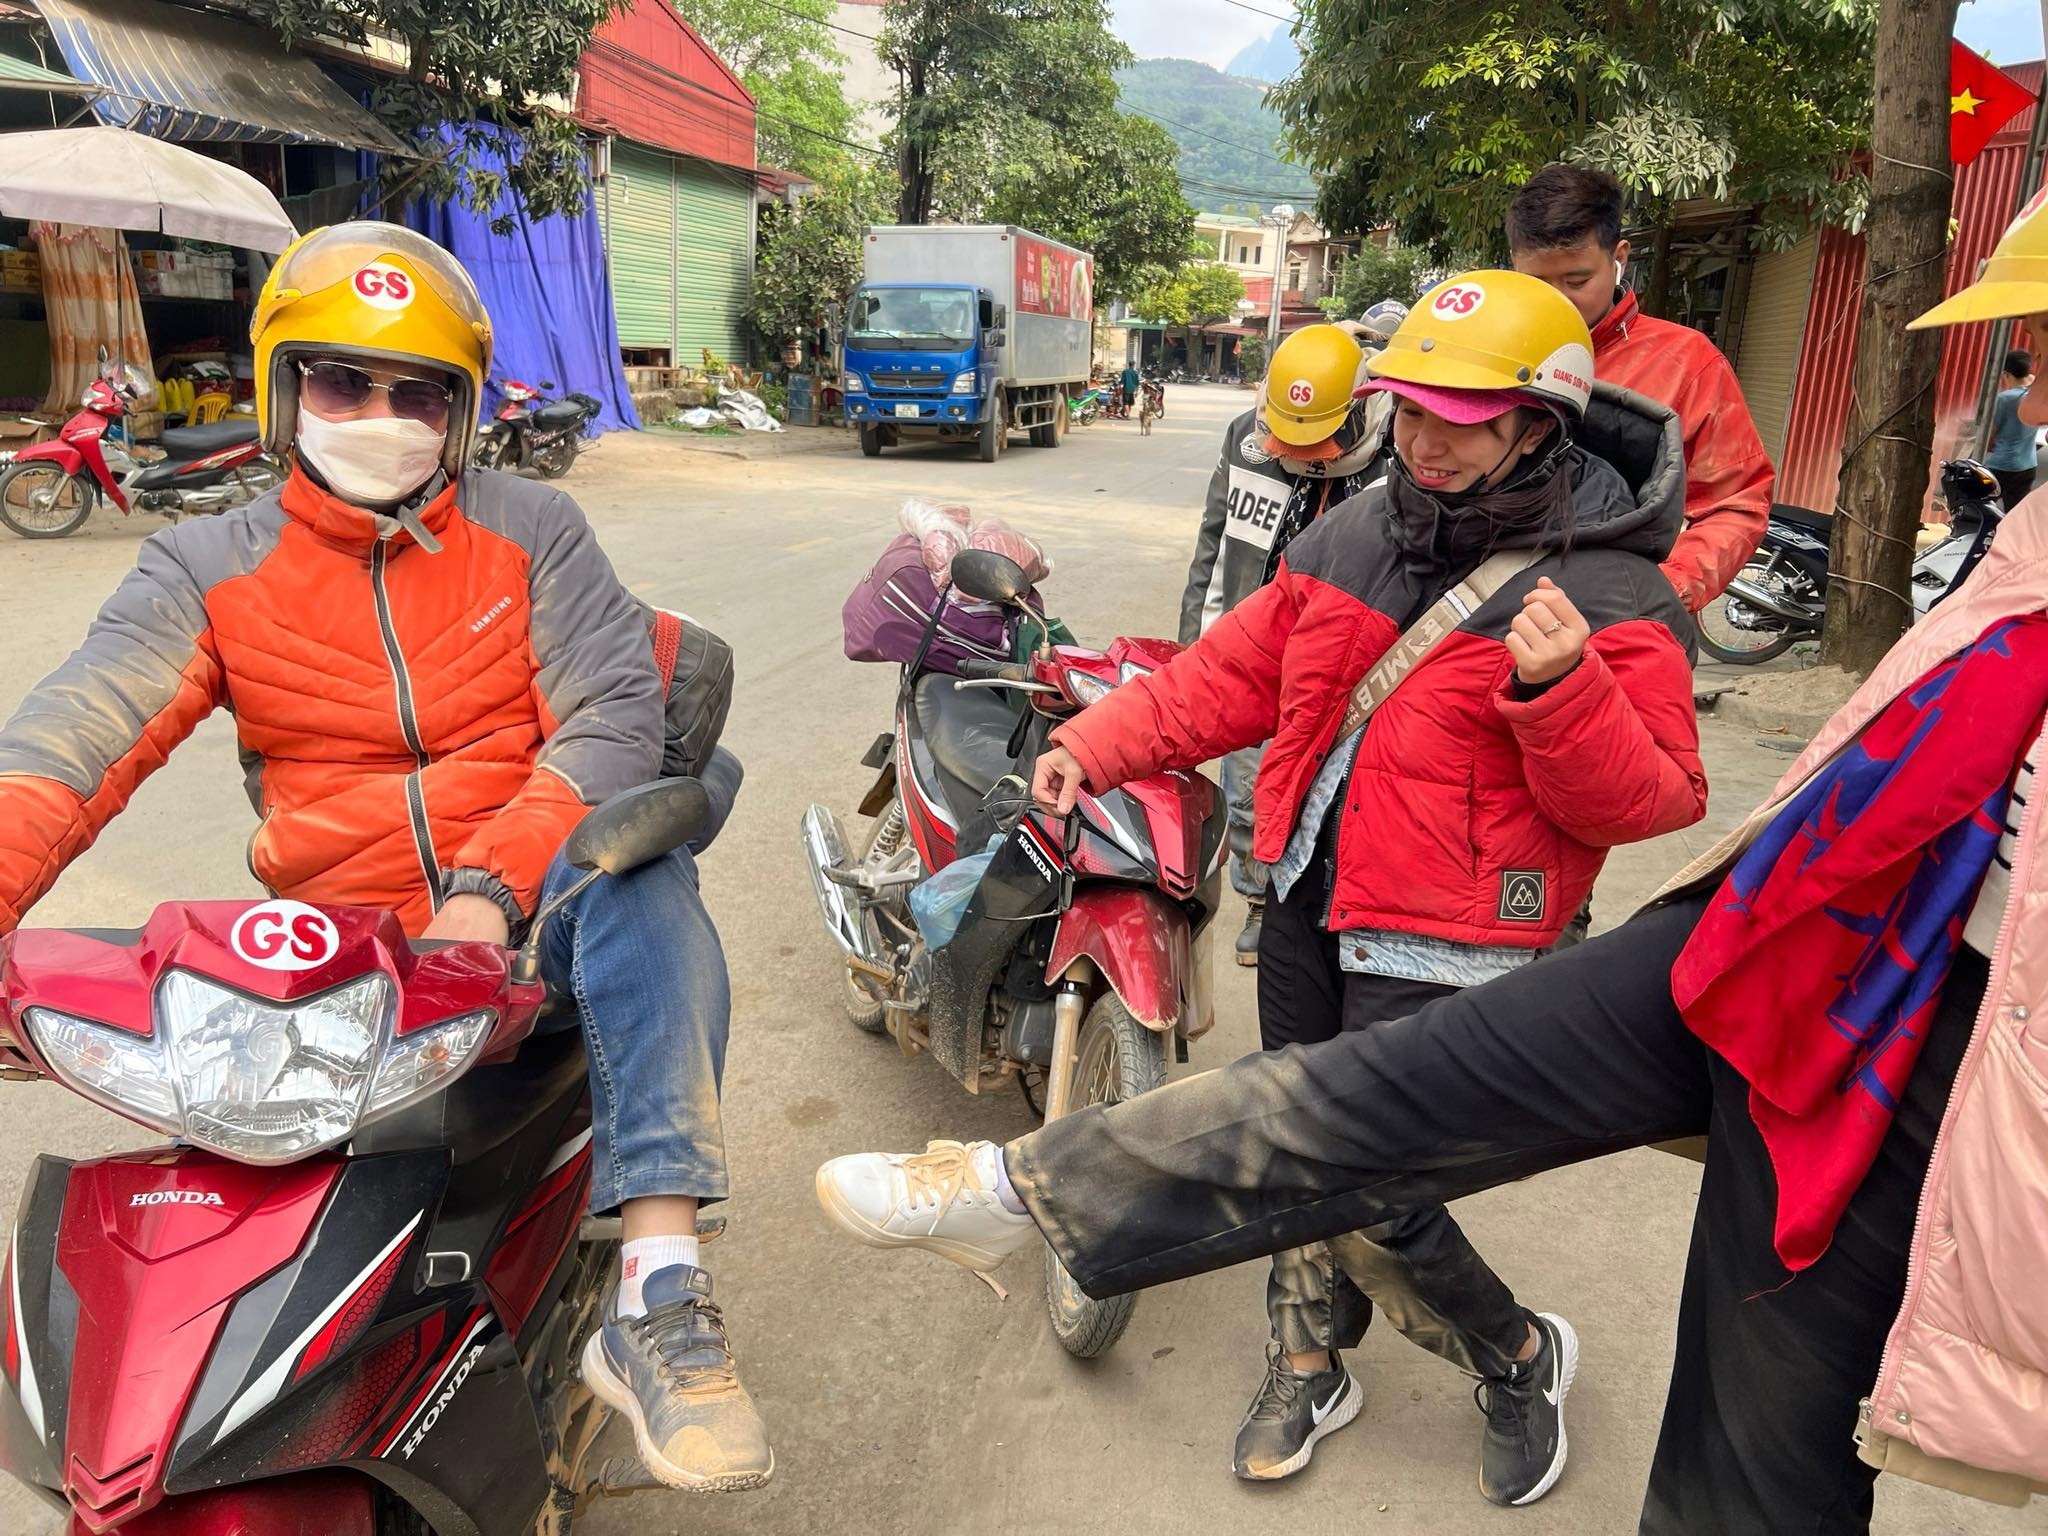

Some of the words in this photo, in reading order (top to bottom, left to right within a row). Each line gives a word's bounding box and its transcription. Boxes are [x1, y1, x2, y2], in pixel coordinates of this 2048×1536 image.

[355, 269, 409, 300] GS
[1435, 288, 1481, 313] GS
[1553, 368, 1573, 384] GIANG
[1289, 384, 1311, 402] GS
[1355, 647, 1411, 711] MLB
[1017, 833, 1052, 883] HONDA
[239, 912, 328, 961] GS
[129, 1190, 225, 1207] HONDA
[402, 1344, 486, 1460] HONDA
